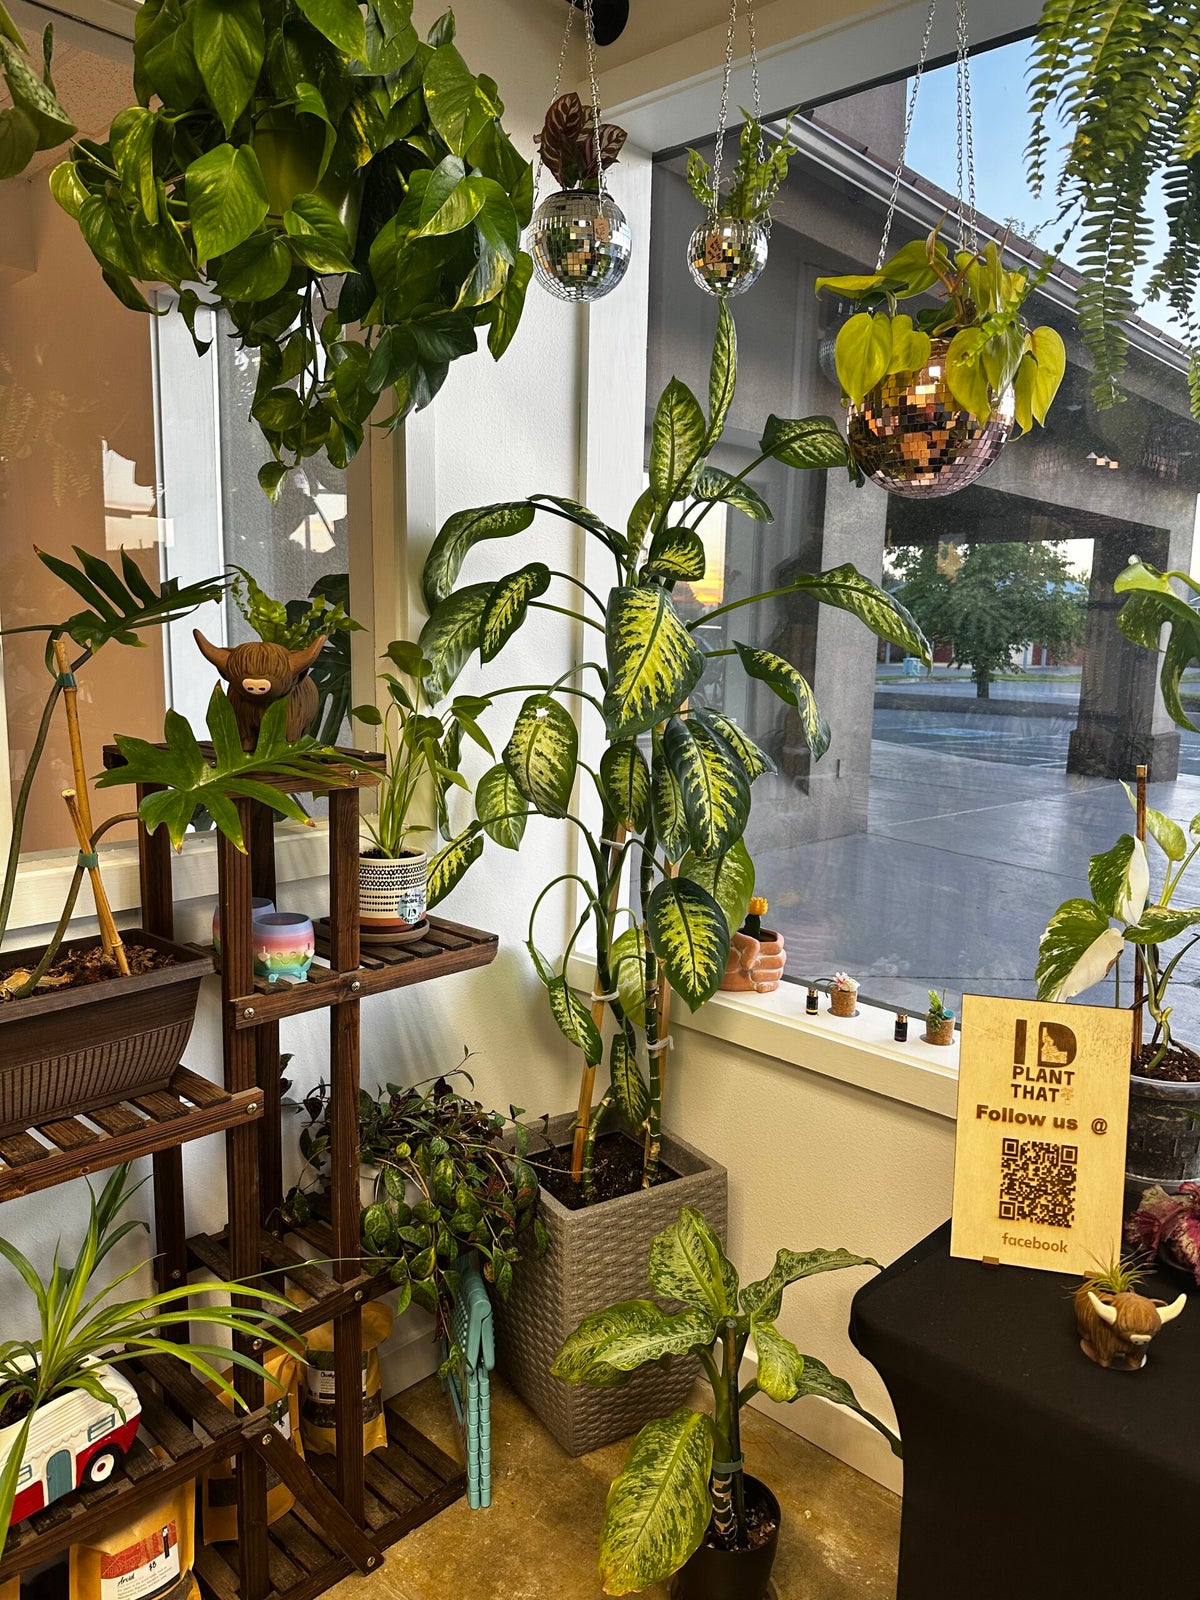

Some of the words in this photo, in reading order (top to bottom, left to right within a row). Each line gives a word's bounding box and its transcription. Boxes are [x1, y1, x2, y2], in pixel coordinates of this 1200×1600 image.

[1013, 1019, 1077, 1068] ID
[1012, 1065, 1075, 1086] PLANT
[1011, 1083, 1060, 1103] THAT
[976, 1104, 1047, 1127] Follow
[1053, 1116, 1079, 1130] us
[1091, 1118, 1108, 1135] @
[1001, 1232, 1068, 1253] facebook
